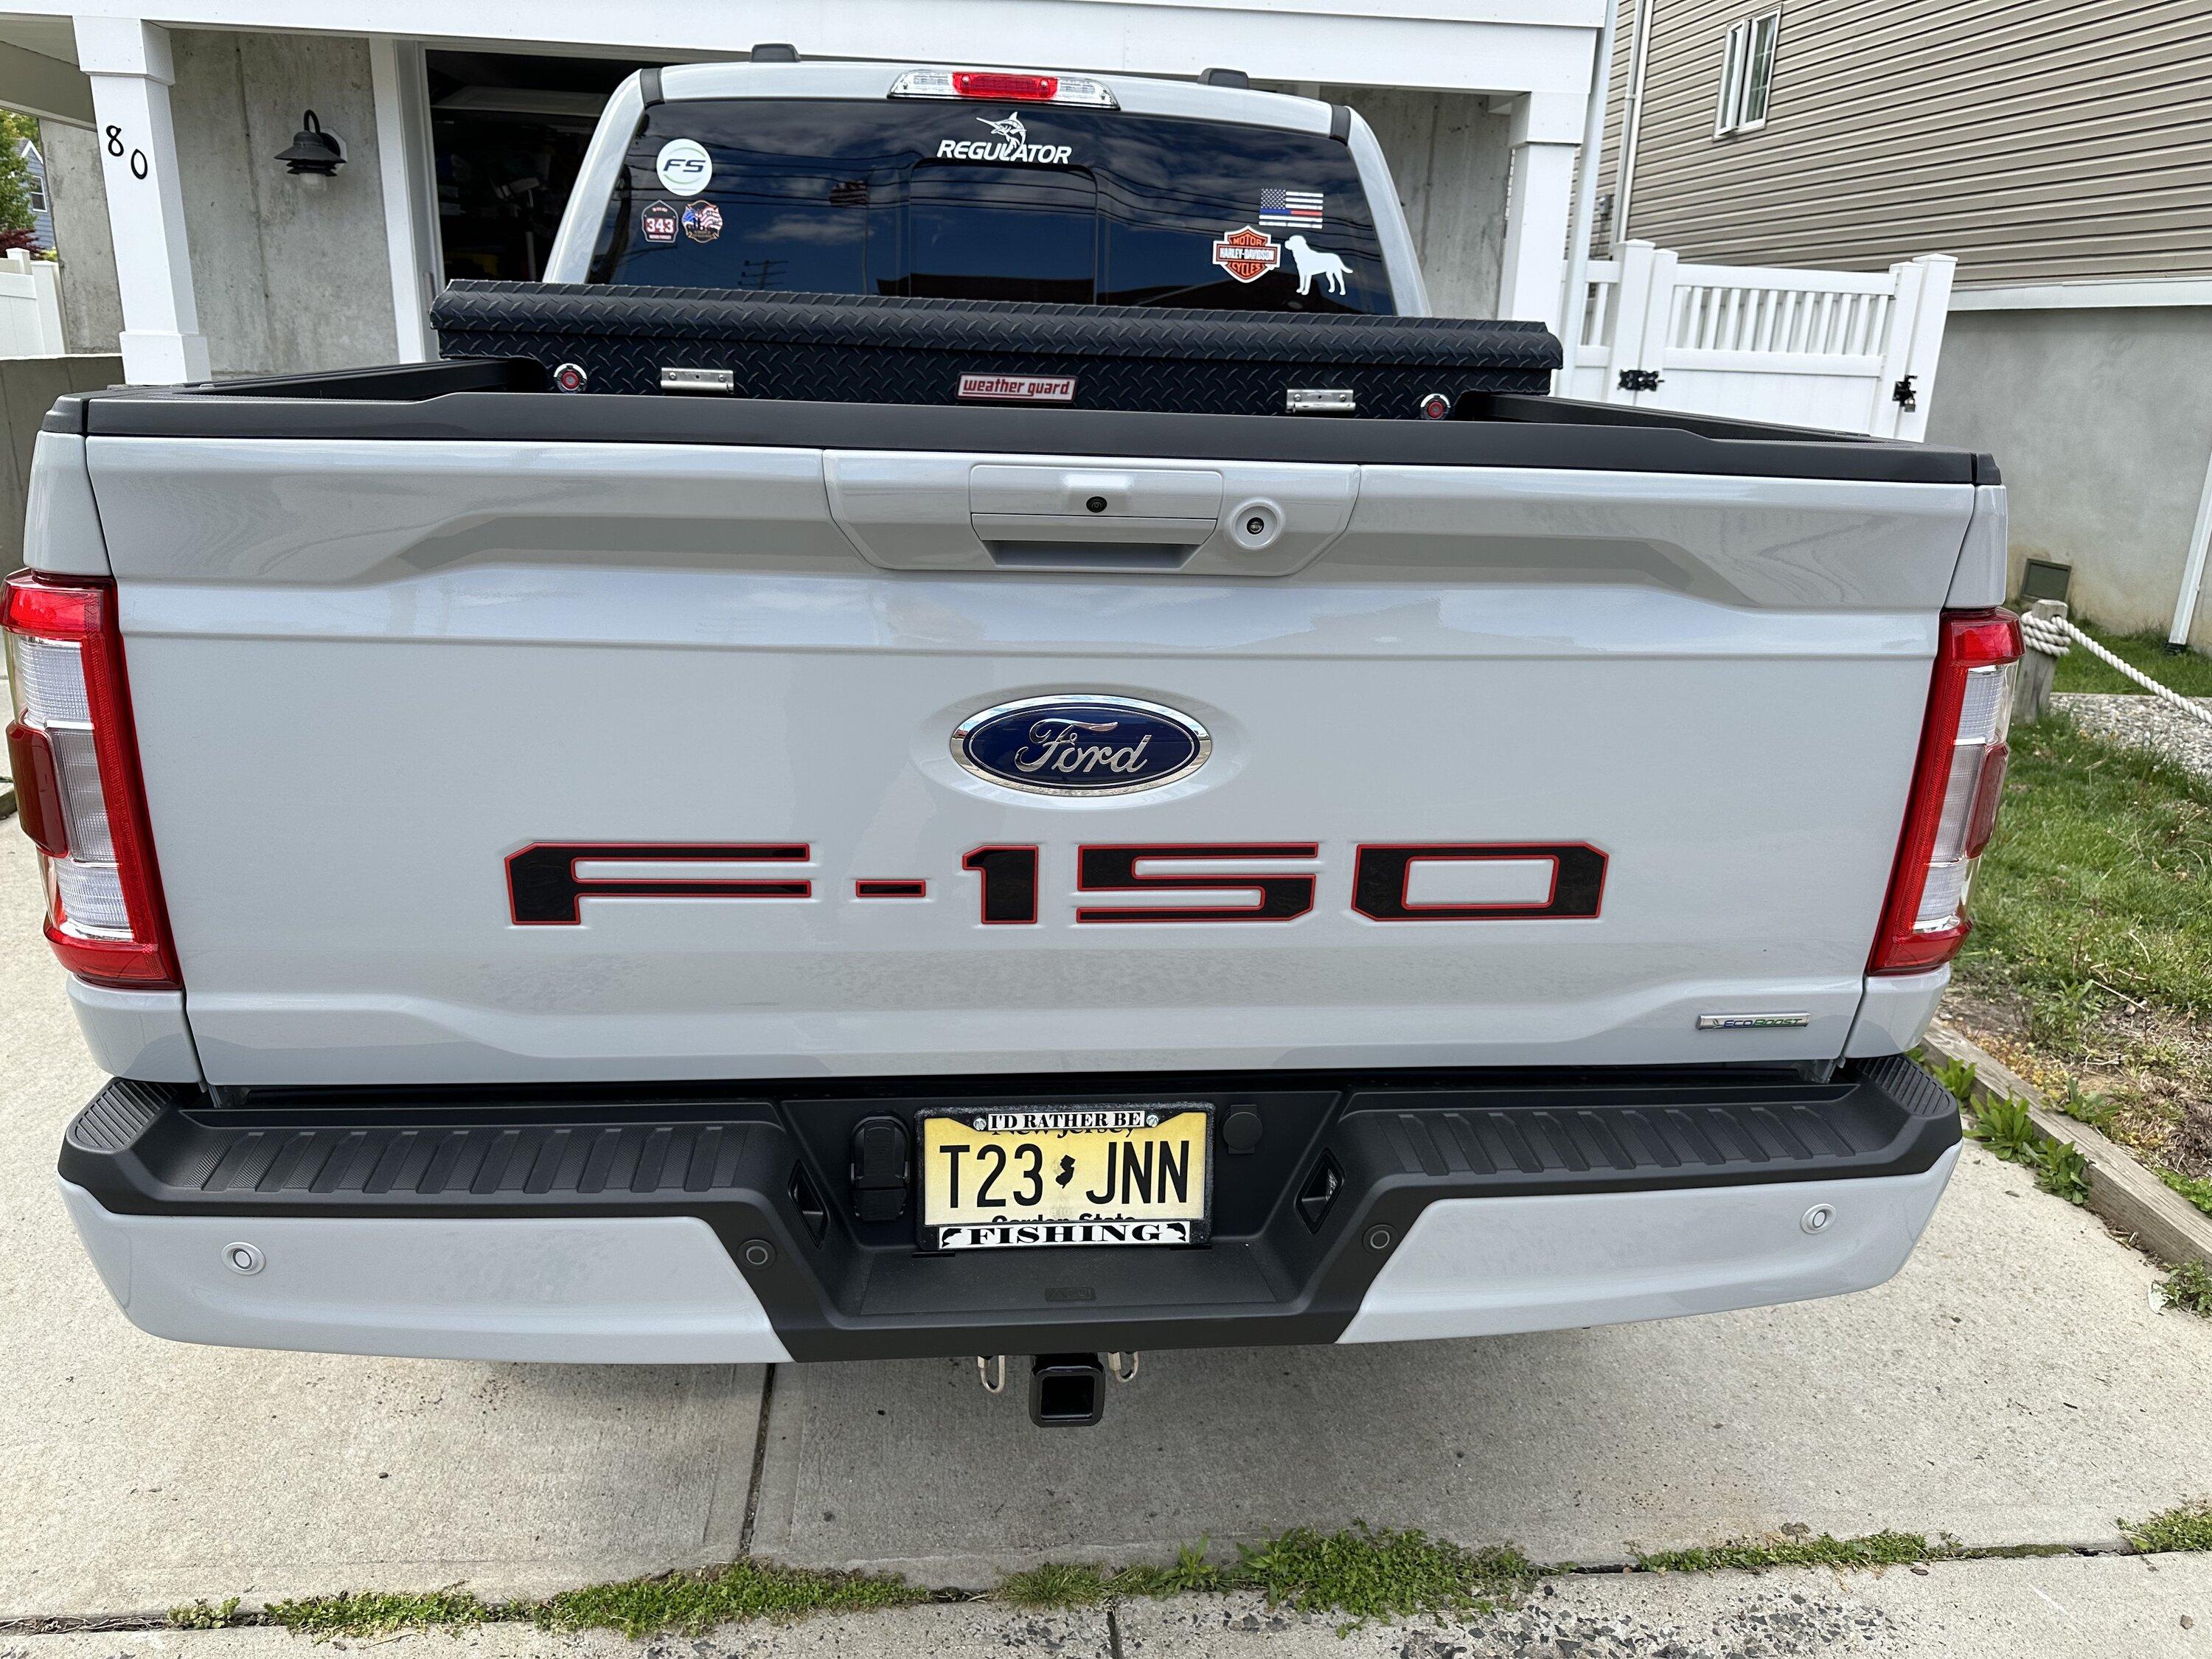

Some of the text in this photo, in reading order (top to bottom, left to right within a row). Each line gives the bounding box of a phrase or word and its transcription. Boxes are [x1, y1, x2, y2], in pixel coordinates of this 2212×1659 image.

[105, 125, 148, 180] 80
[936, 139, 1072, 164] REGULATOR
[663, 159, 706, 173] FS
[647, 218, 674, 233] 343
[1233, 234, 1262, 246] MOTOR
[1231, 262, 1261, 276] CYCLES
[963, 378, 1071, 397] weather guard
[1015, 717, 1152, 773] Ford
[504, 842, 1609, 925] F-150
[991, 1111, 1141, 1129] I'D RATHER BE
[939, 1140, 1189, 1208] T23 JNN
[970, 1224, 1162, 1245] FISHING
